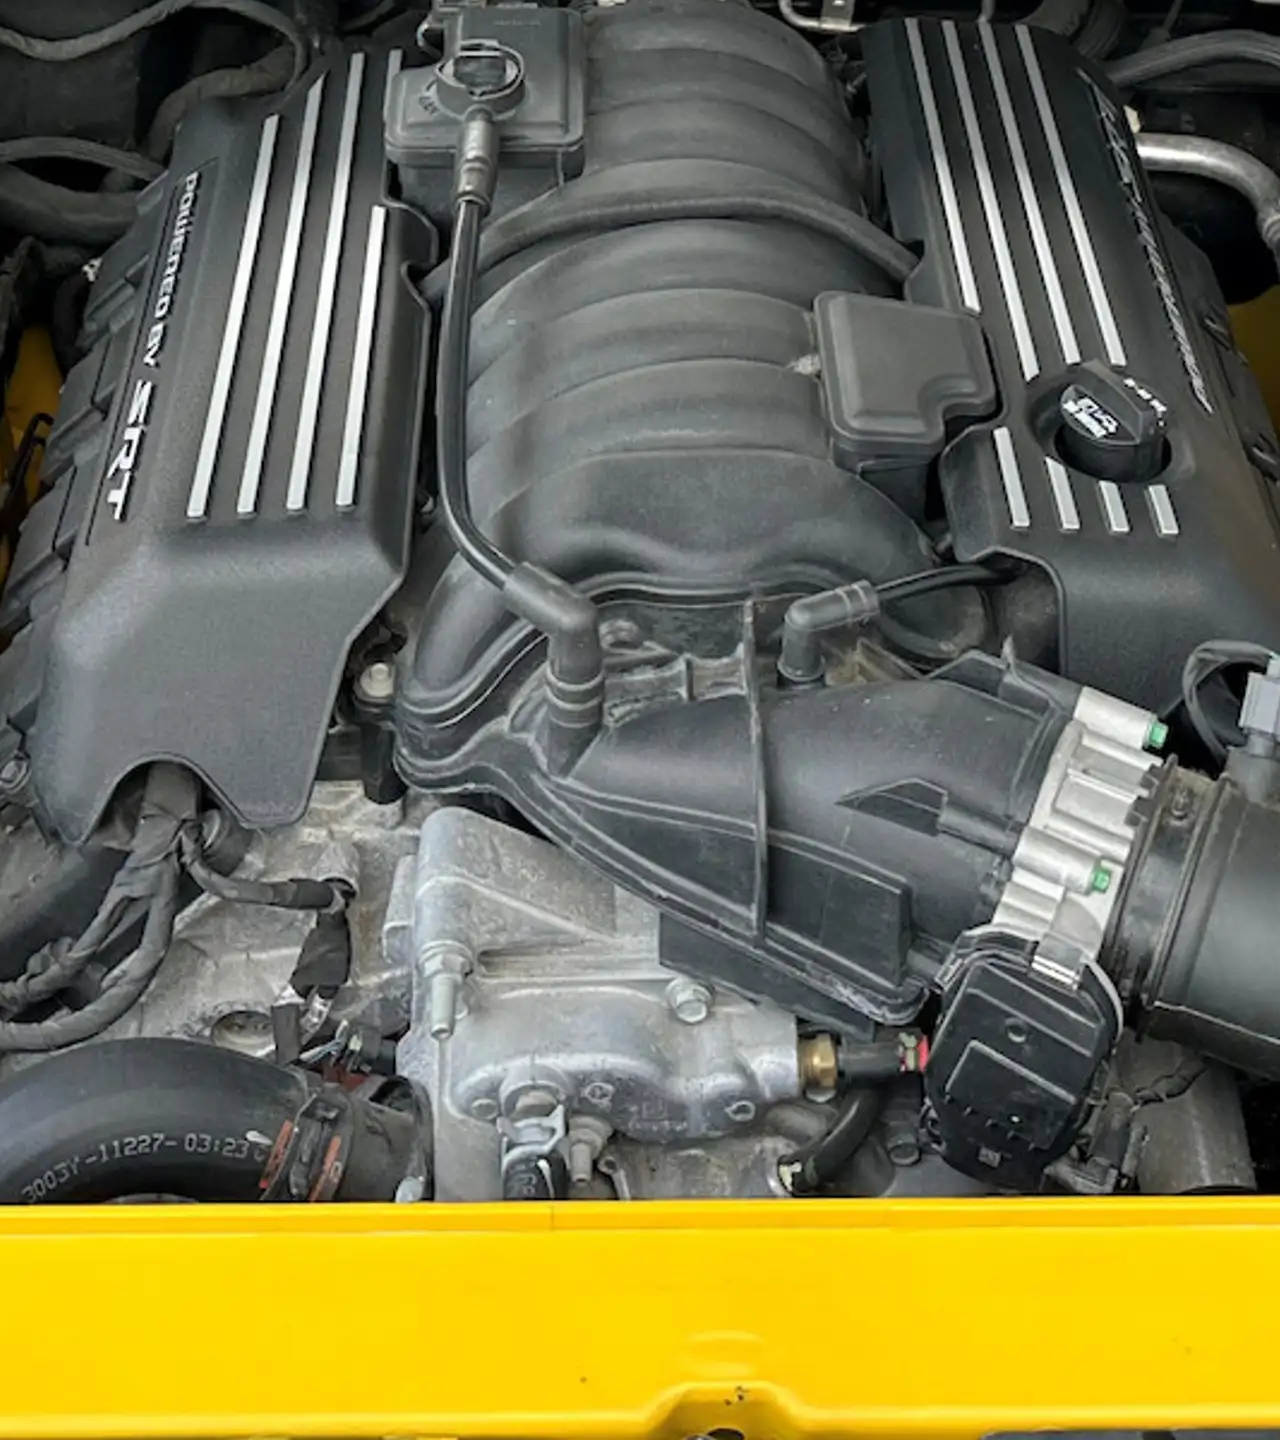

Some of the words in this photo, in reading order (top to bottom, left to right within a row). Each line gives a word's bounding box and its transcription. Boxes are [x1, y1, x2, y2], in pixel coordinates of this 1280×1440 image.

[154, 171, 199, 318] POWERED
[143, 321, 165, 367] BY
[107, 380, 153, 521] SRT
